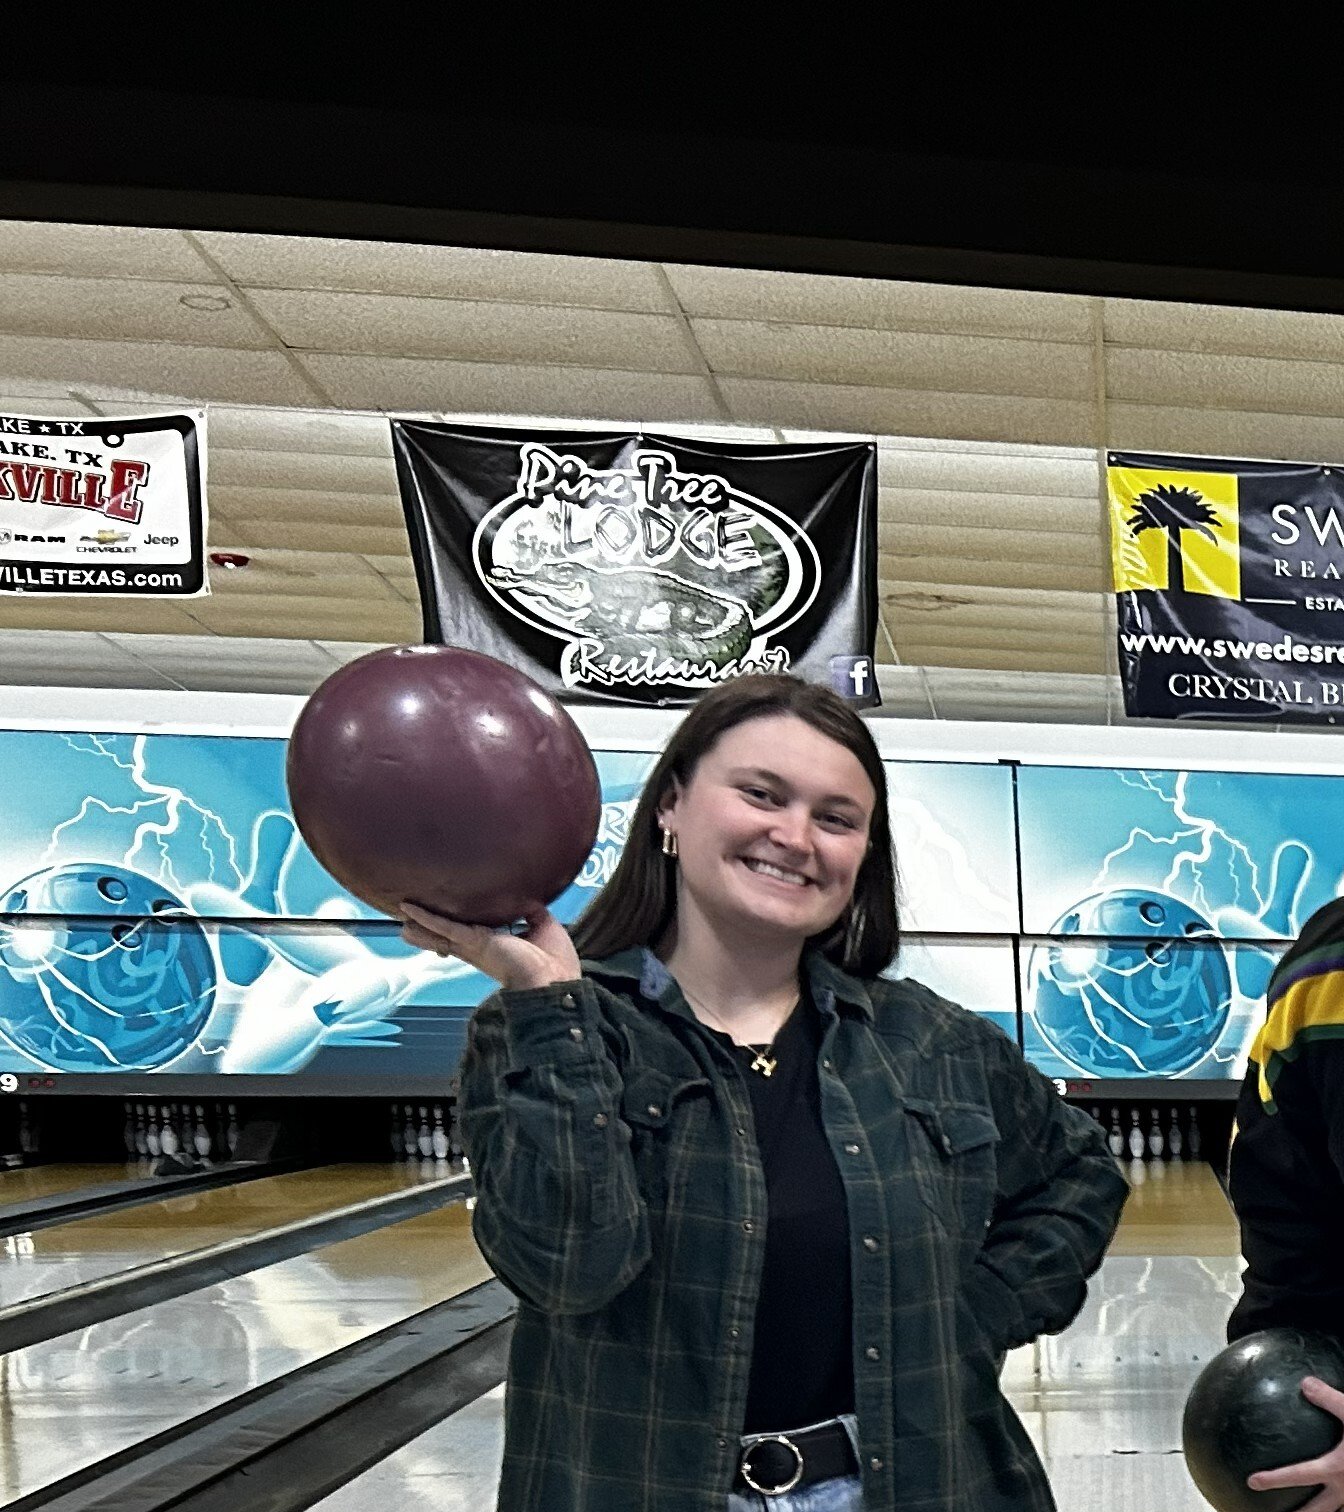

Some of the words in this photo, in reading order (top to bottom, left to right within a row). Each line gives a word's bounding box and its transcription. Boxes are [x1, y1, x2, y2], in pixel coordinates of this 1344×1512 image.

[0, 419, 31, 434] KE
[56, 423, 85, 435] TX
[65, 449, 103, 468] TX
[526, 450, 629, 500] Pine
[639, 457, 722, 502] Tree
[14, 534, 66, 543] RAM
[143, 534, 179, 547] Jeep
[562, 503, 763, 568] LODGE
[1167, 673, 1314, 705] CRYSTAL
